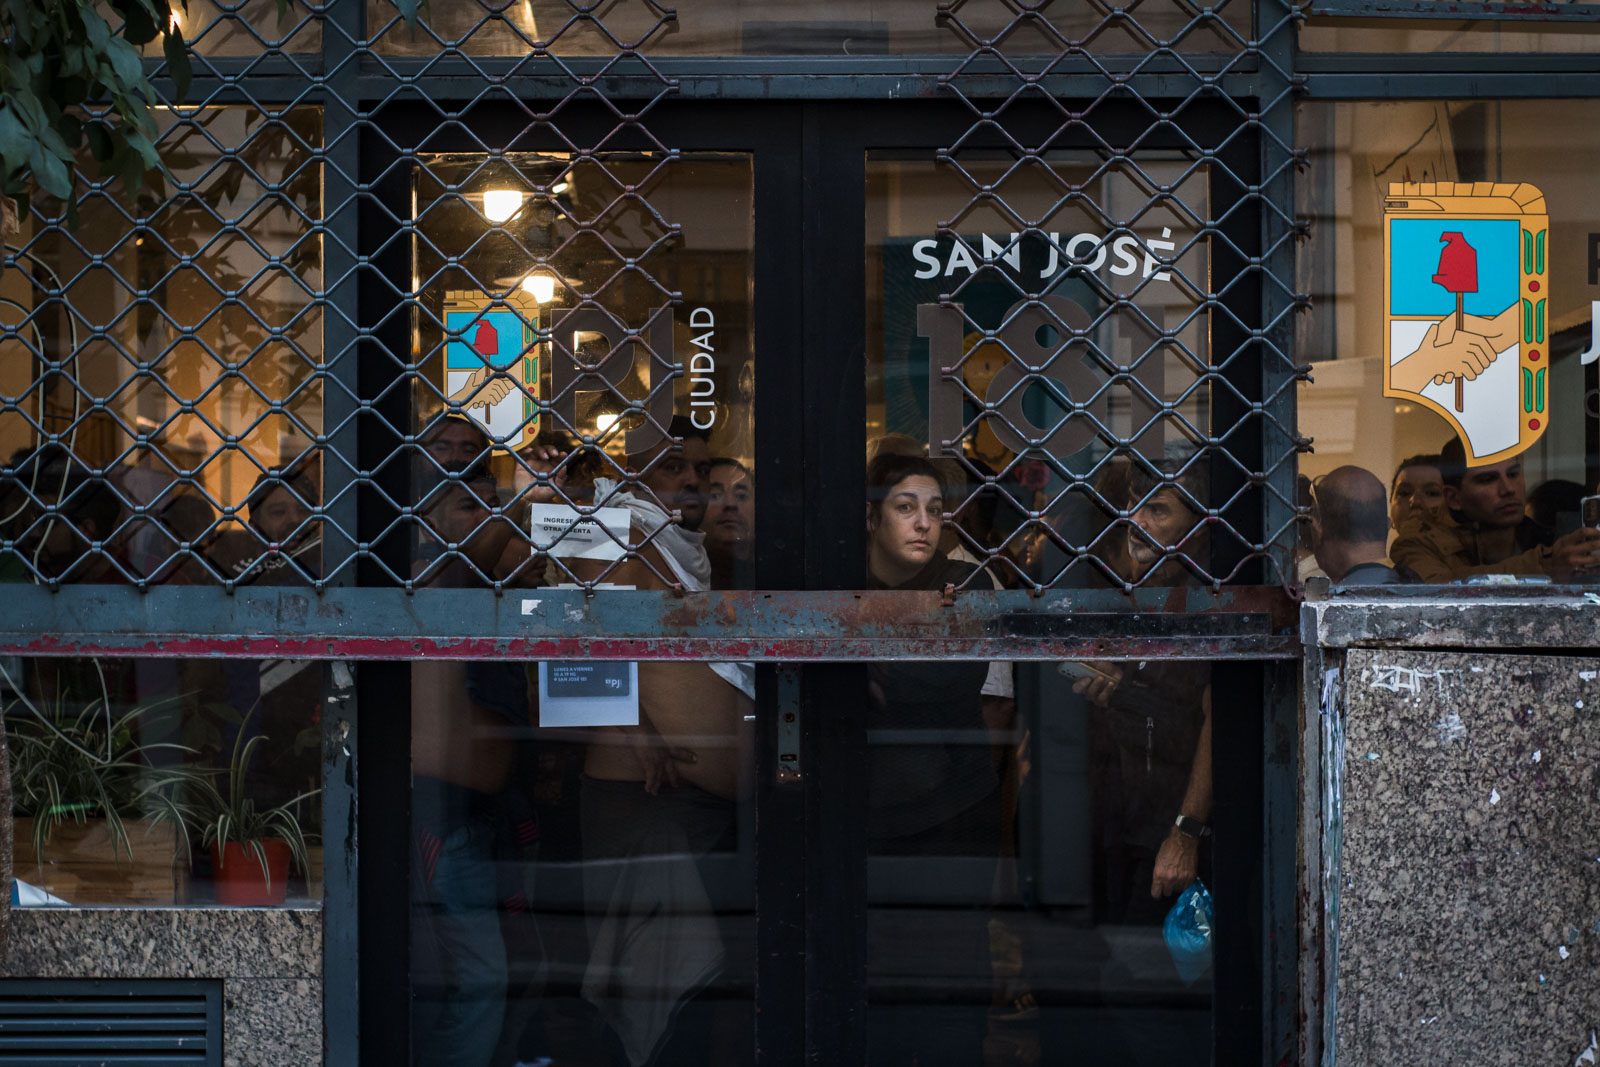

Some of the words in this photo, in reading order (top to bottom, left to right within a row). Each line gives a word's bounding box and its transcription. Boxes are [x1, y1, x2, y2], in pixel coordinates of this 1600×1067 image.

[912, 232, 1021, 279] SAN
[1040, 227, 1176, 283] JOSÉ
[551, 308, 674, 456] PJ
[689, 307, 715, 431] CIUDAD
[917, 294, 1165, 460] 181
[543, 517, 574, 525] INGRESE
